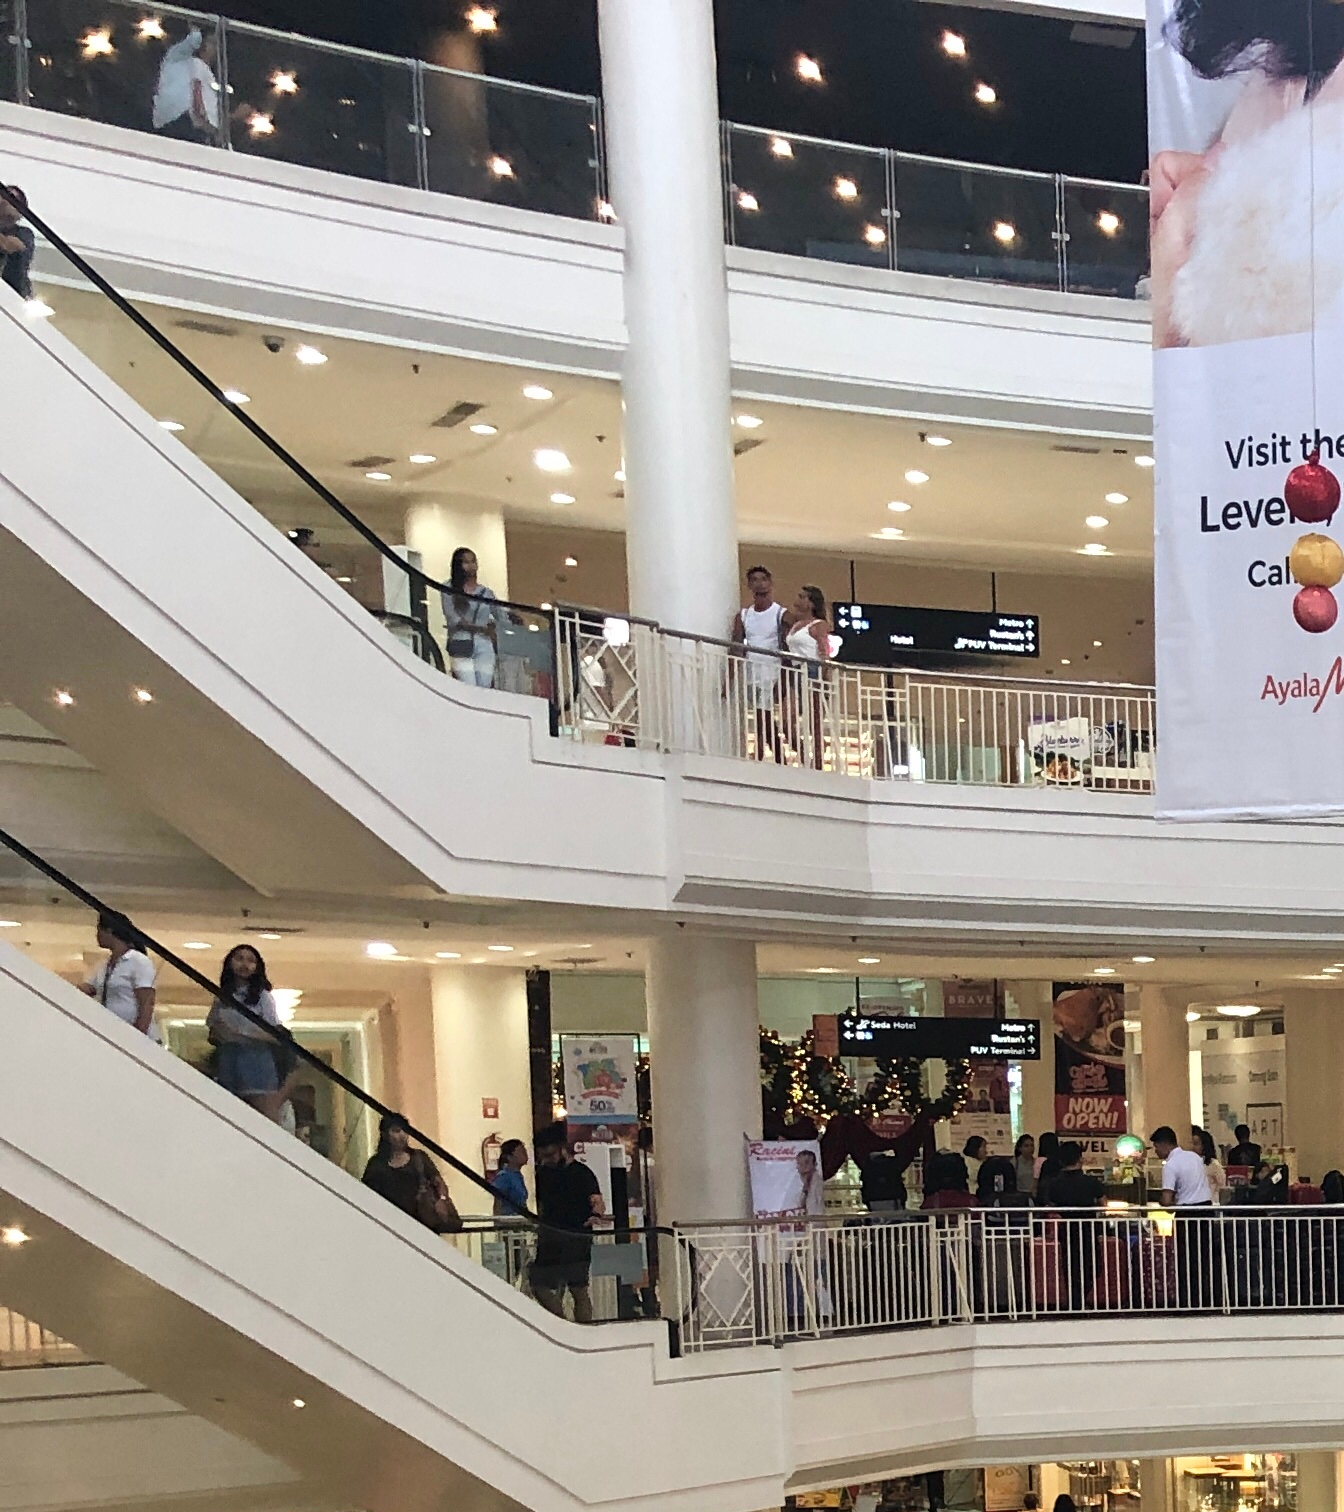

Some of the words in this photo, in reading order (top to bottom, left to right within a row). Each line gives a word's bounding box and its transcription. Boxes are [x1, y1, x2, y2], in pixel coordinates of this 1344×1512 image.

[1225, 433, 1291, 468] Visit
[1201, 495, 1295, 533] Leve
[1247, 557, 1298, 588] Cal
[871, 1020, 890, 1029] Seda
[893, 1021, 916, 1030] Hotel
[970, 1046, 988, 1055] PUV
[990, 1046, 1025, 1056] Terminal
[1068, 1097, 1113, 1114] NOW
[1062, 1111, 1119, 1129] OPEN!
